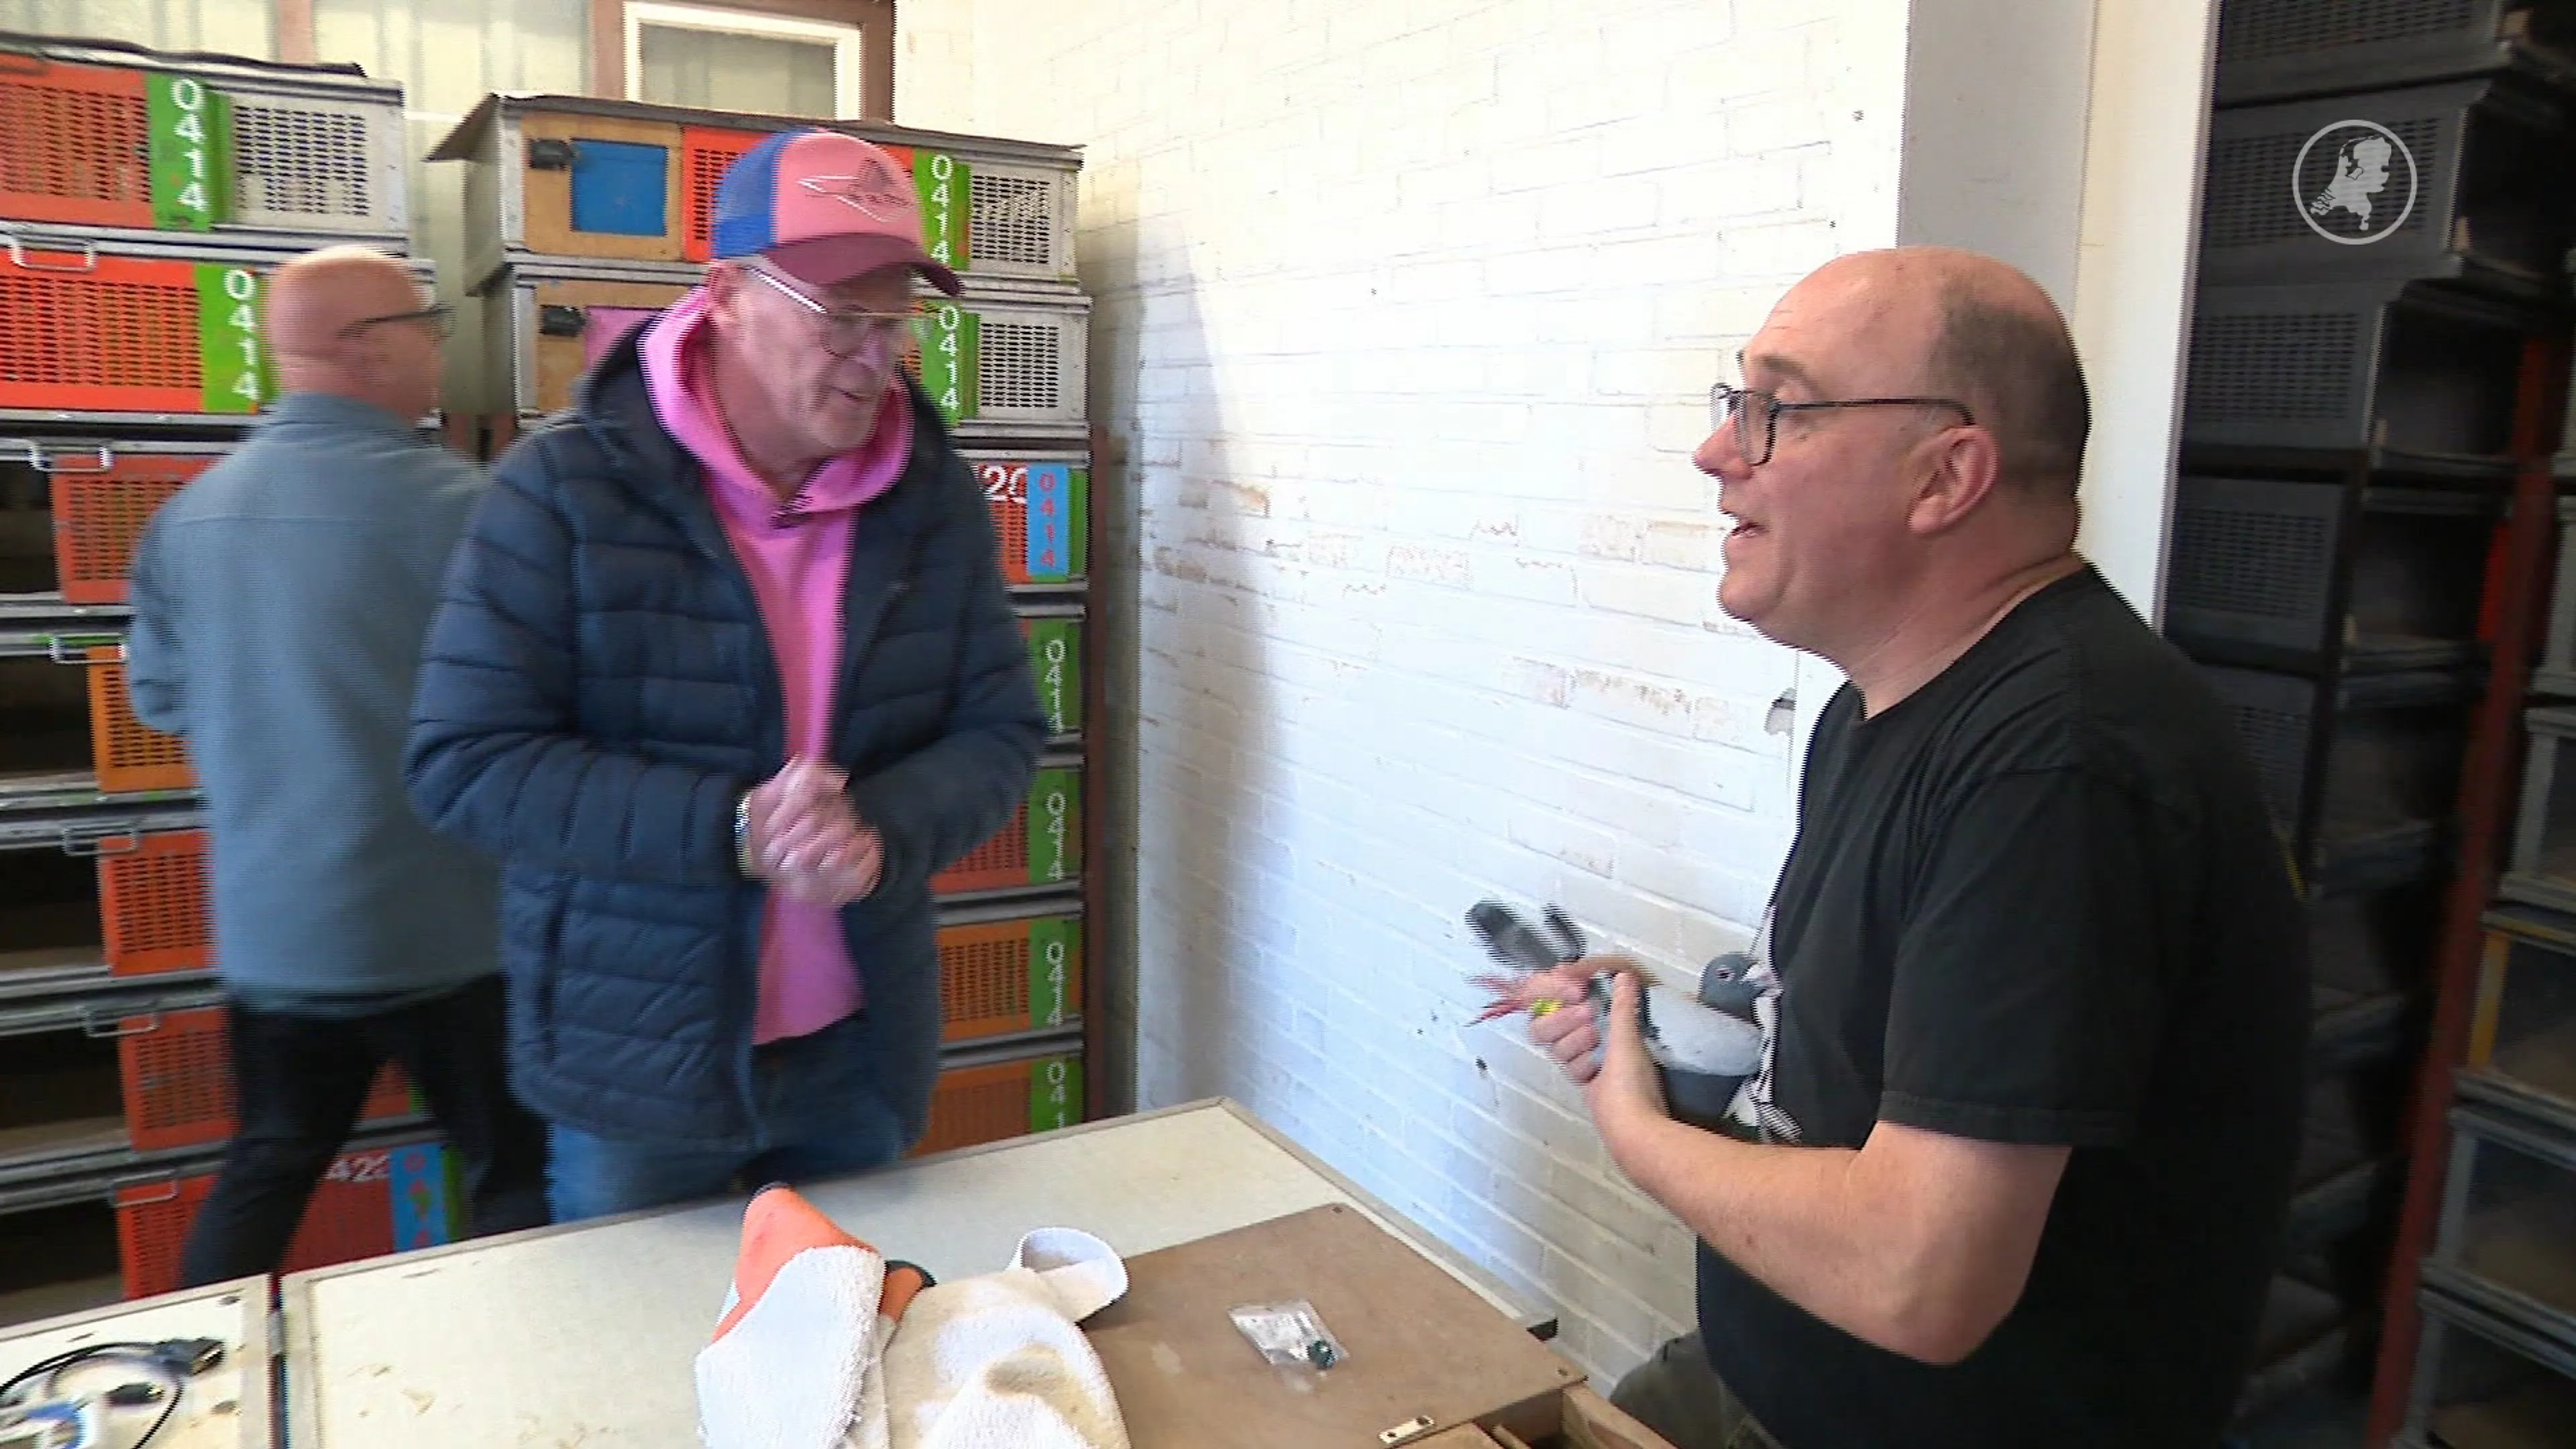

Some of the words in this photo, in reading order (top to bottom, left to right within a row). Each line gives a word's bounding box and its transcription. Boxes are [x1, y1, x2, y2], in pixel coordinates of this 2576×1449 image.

[171, 78, 205, 211] 0414
[930, 155, 953, 264] 0414
[223, 270, 260, 399] 0414
[938, 307, 960, 410] 0414
[1040, 472, 1056, 568] 0414
[1045, 639, 1065, 733] 0414
[1048, 792, 1067, 879] 0414
[1047, 941, 1065, 1026] 0414
